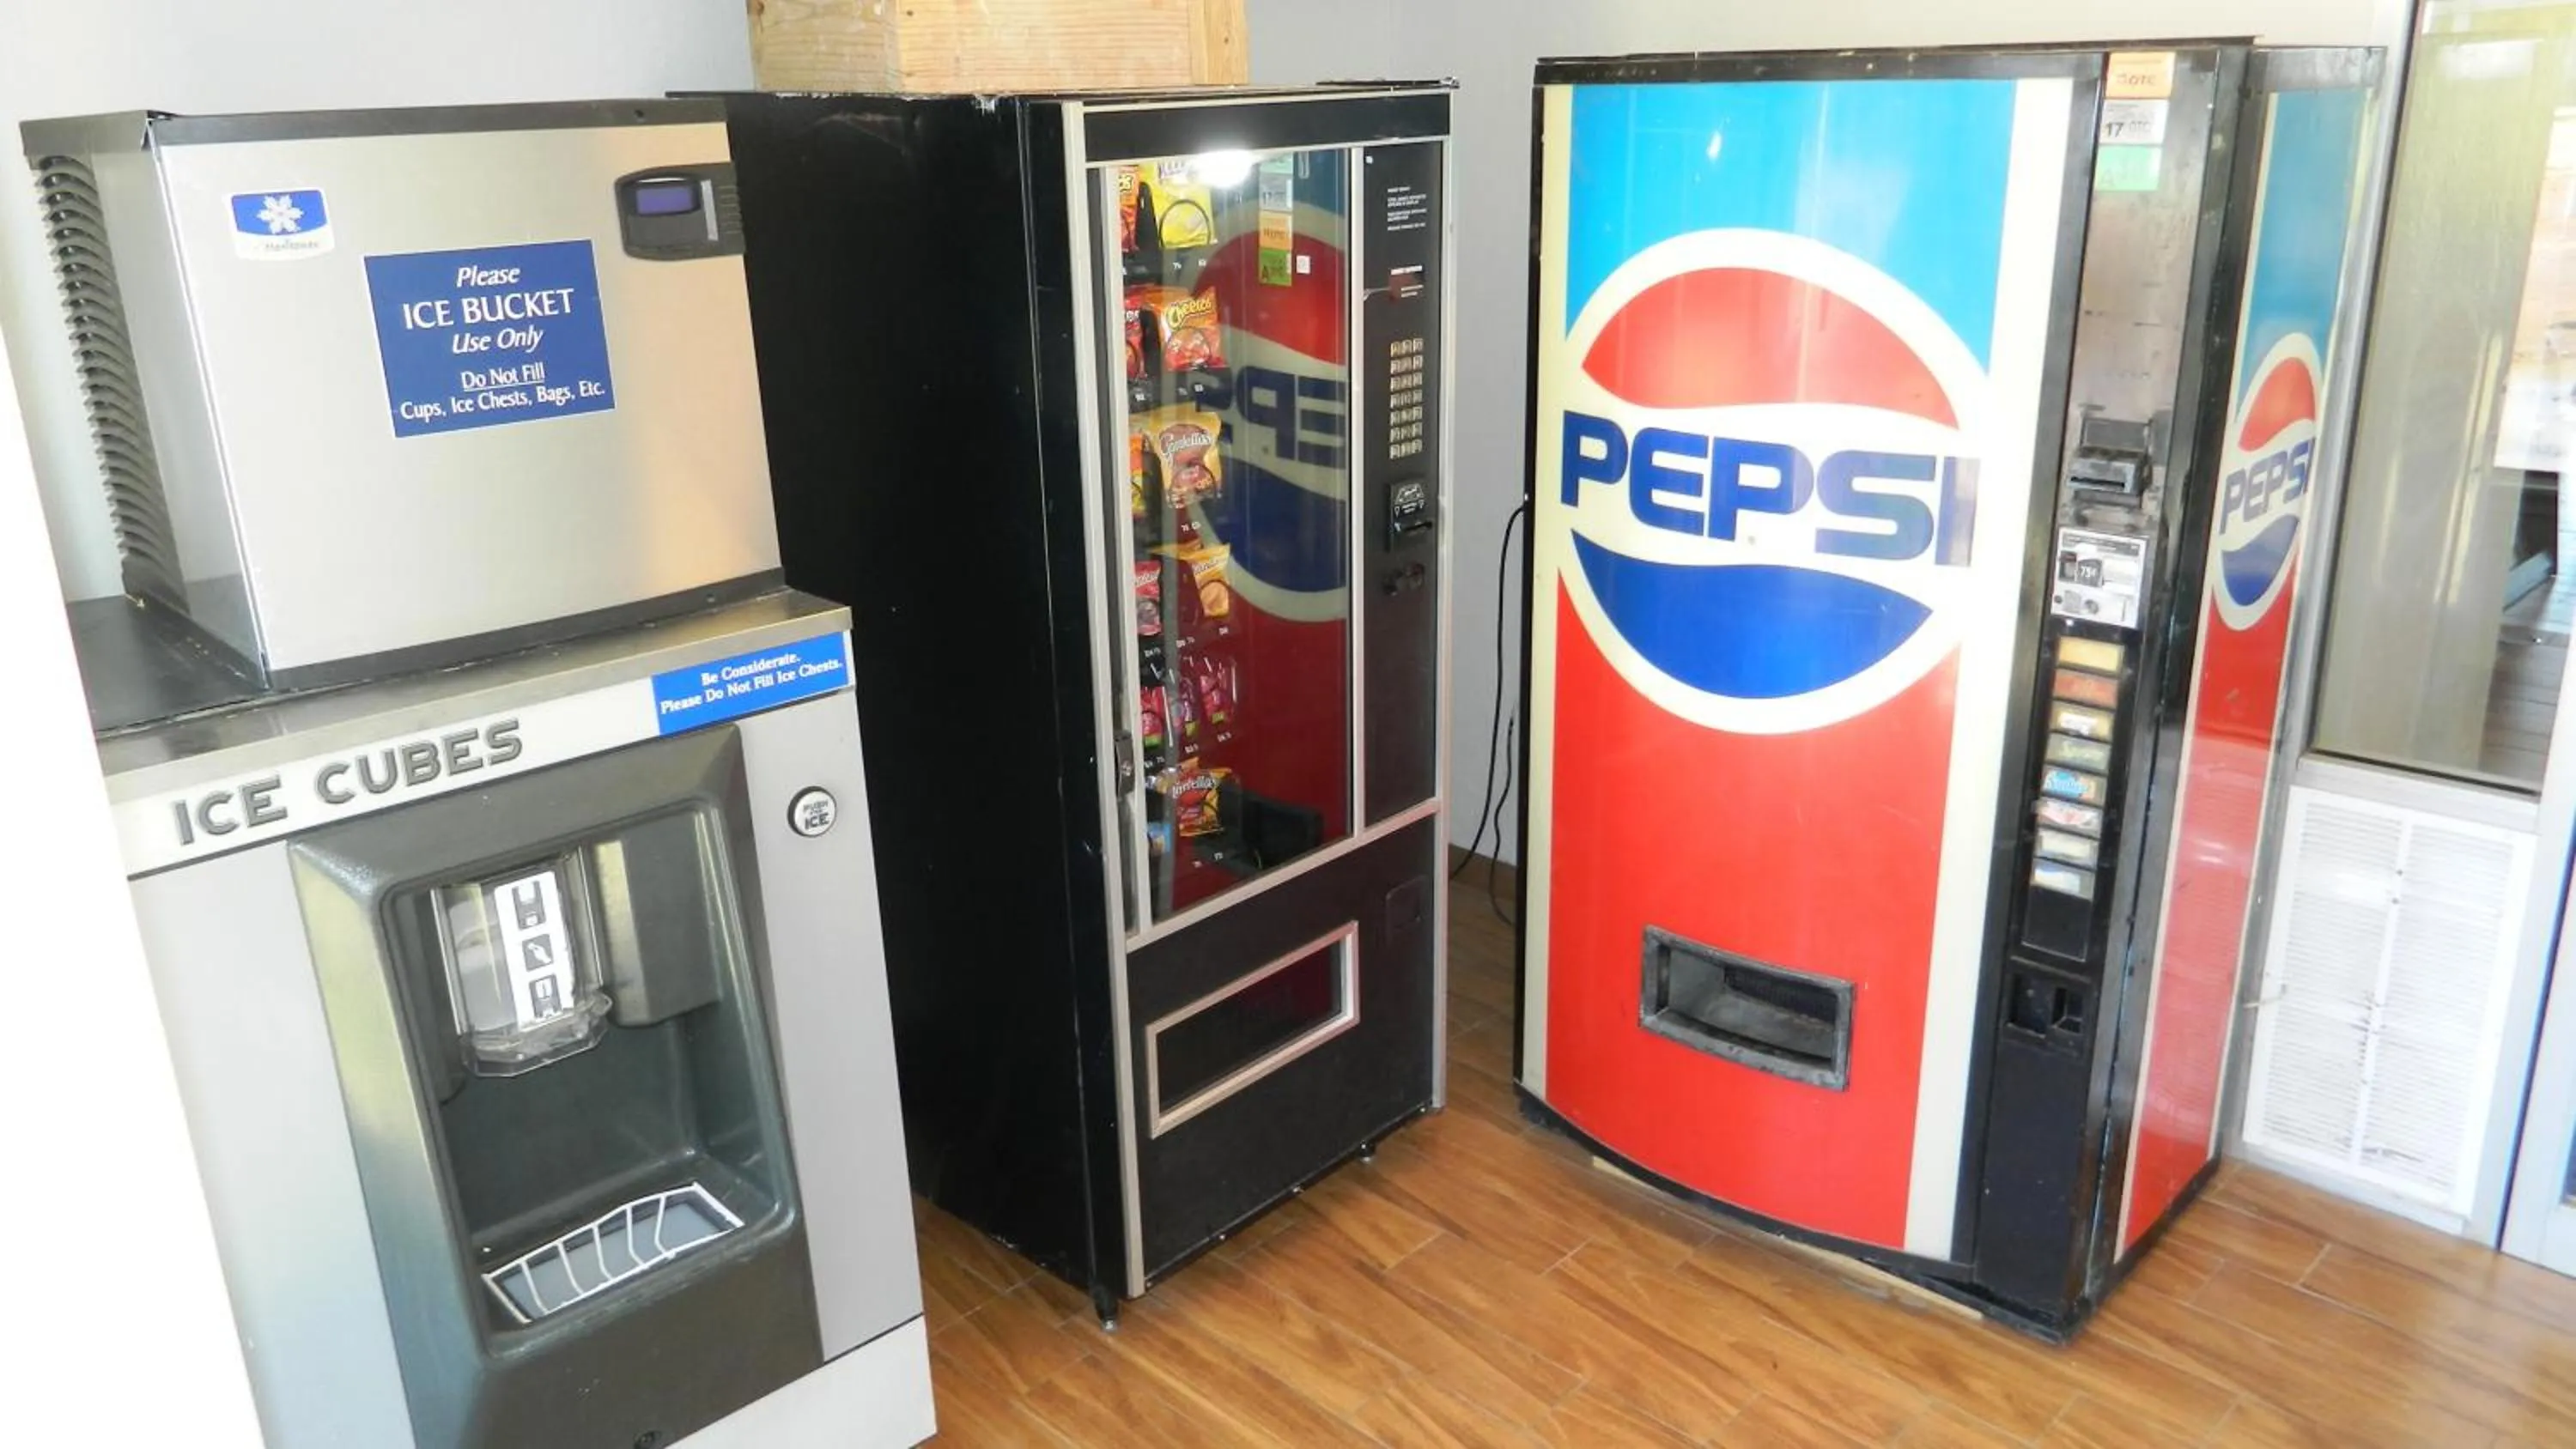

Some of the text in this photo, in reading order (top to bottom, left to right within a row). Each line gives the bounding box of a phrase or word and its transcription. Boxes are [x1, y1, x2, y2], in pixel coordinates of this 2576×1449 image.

[456, 264, 520, 288] Please
[402, 288, 574, 330] ICE BUCKET
[452, 324, 544, 355] Use Only
[460, 361, 545, 388] Do Not Fill
[400, 380, 605, 422] Cups, Ice Chests, Bags, Etc.
[1560, 409, 1981, 567] PEPSI
[2219, 436, 2316, 536] PEPSI
[659, 658, 843, 714] Please Do Not Fill Ice Chests.
[701, 652, 801, 686] Be Considerate.
[172, 717, 524, 846] ICE CUBES
[805, 812, 829, 830] ICE
